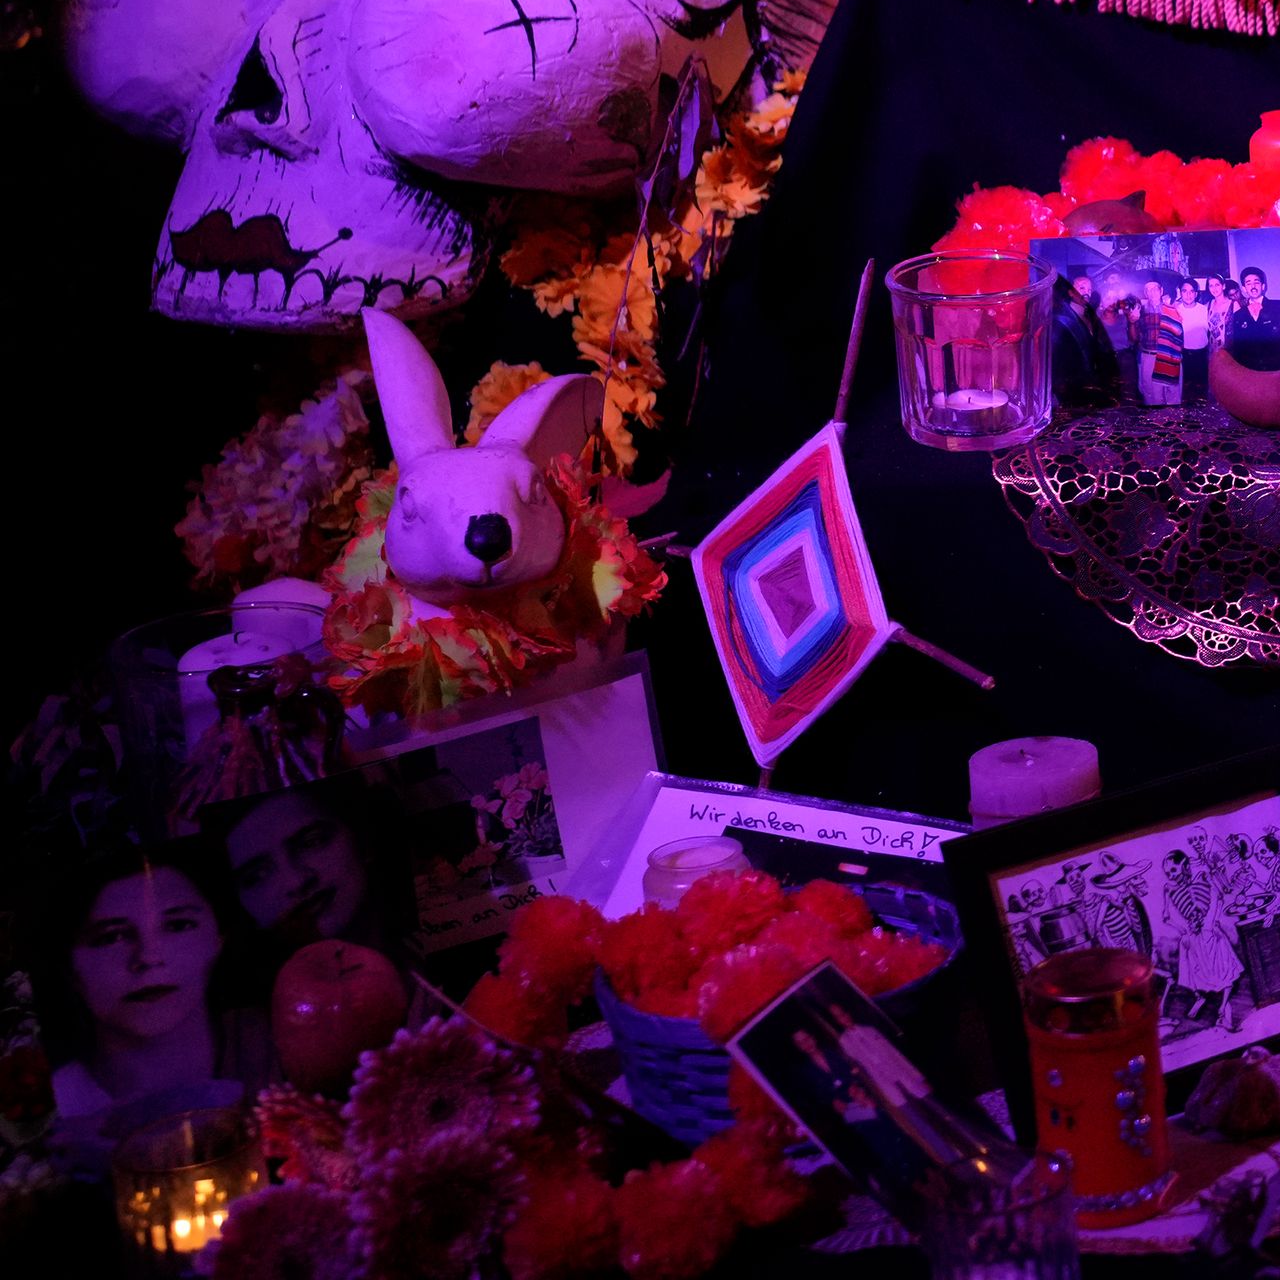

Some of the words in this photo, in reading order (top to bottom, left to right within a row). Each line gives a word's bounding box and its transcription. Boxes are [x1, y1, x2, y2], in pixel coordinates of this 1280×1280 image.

[690, 803, 726, 822] Wir
[729, 811, 805, 835] denken
[816, 827, 847, 841] an
[472, 908, 500, 924] an
